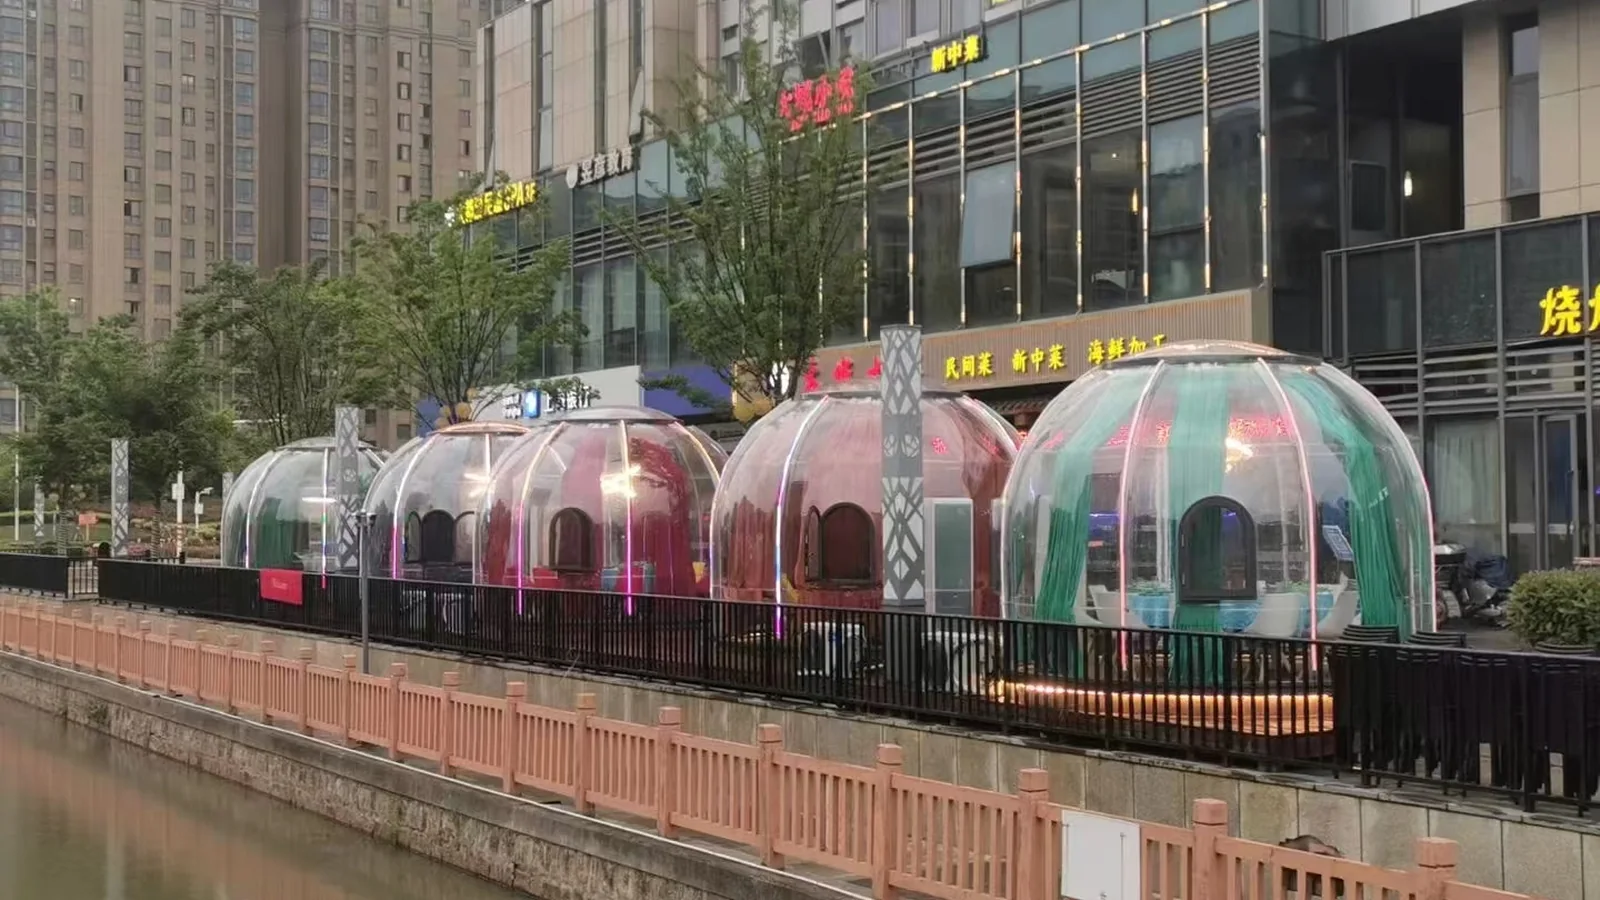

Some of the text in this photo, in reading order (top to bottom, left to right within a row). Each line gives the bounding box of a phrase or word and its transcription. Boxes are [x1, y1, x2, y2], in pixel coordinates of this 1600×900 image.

[1012, 344, 1065, 373] 新中菜
[1088, 334, 1166, 364] 海鲜加工
[945, 351, 993, 379] 民间菜
